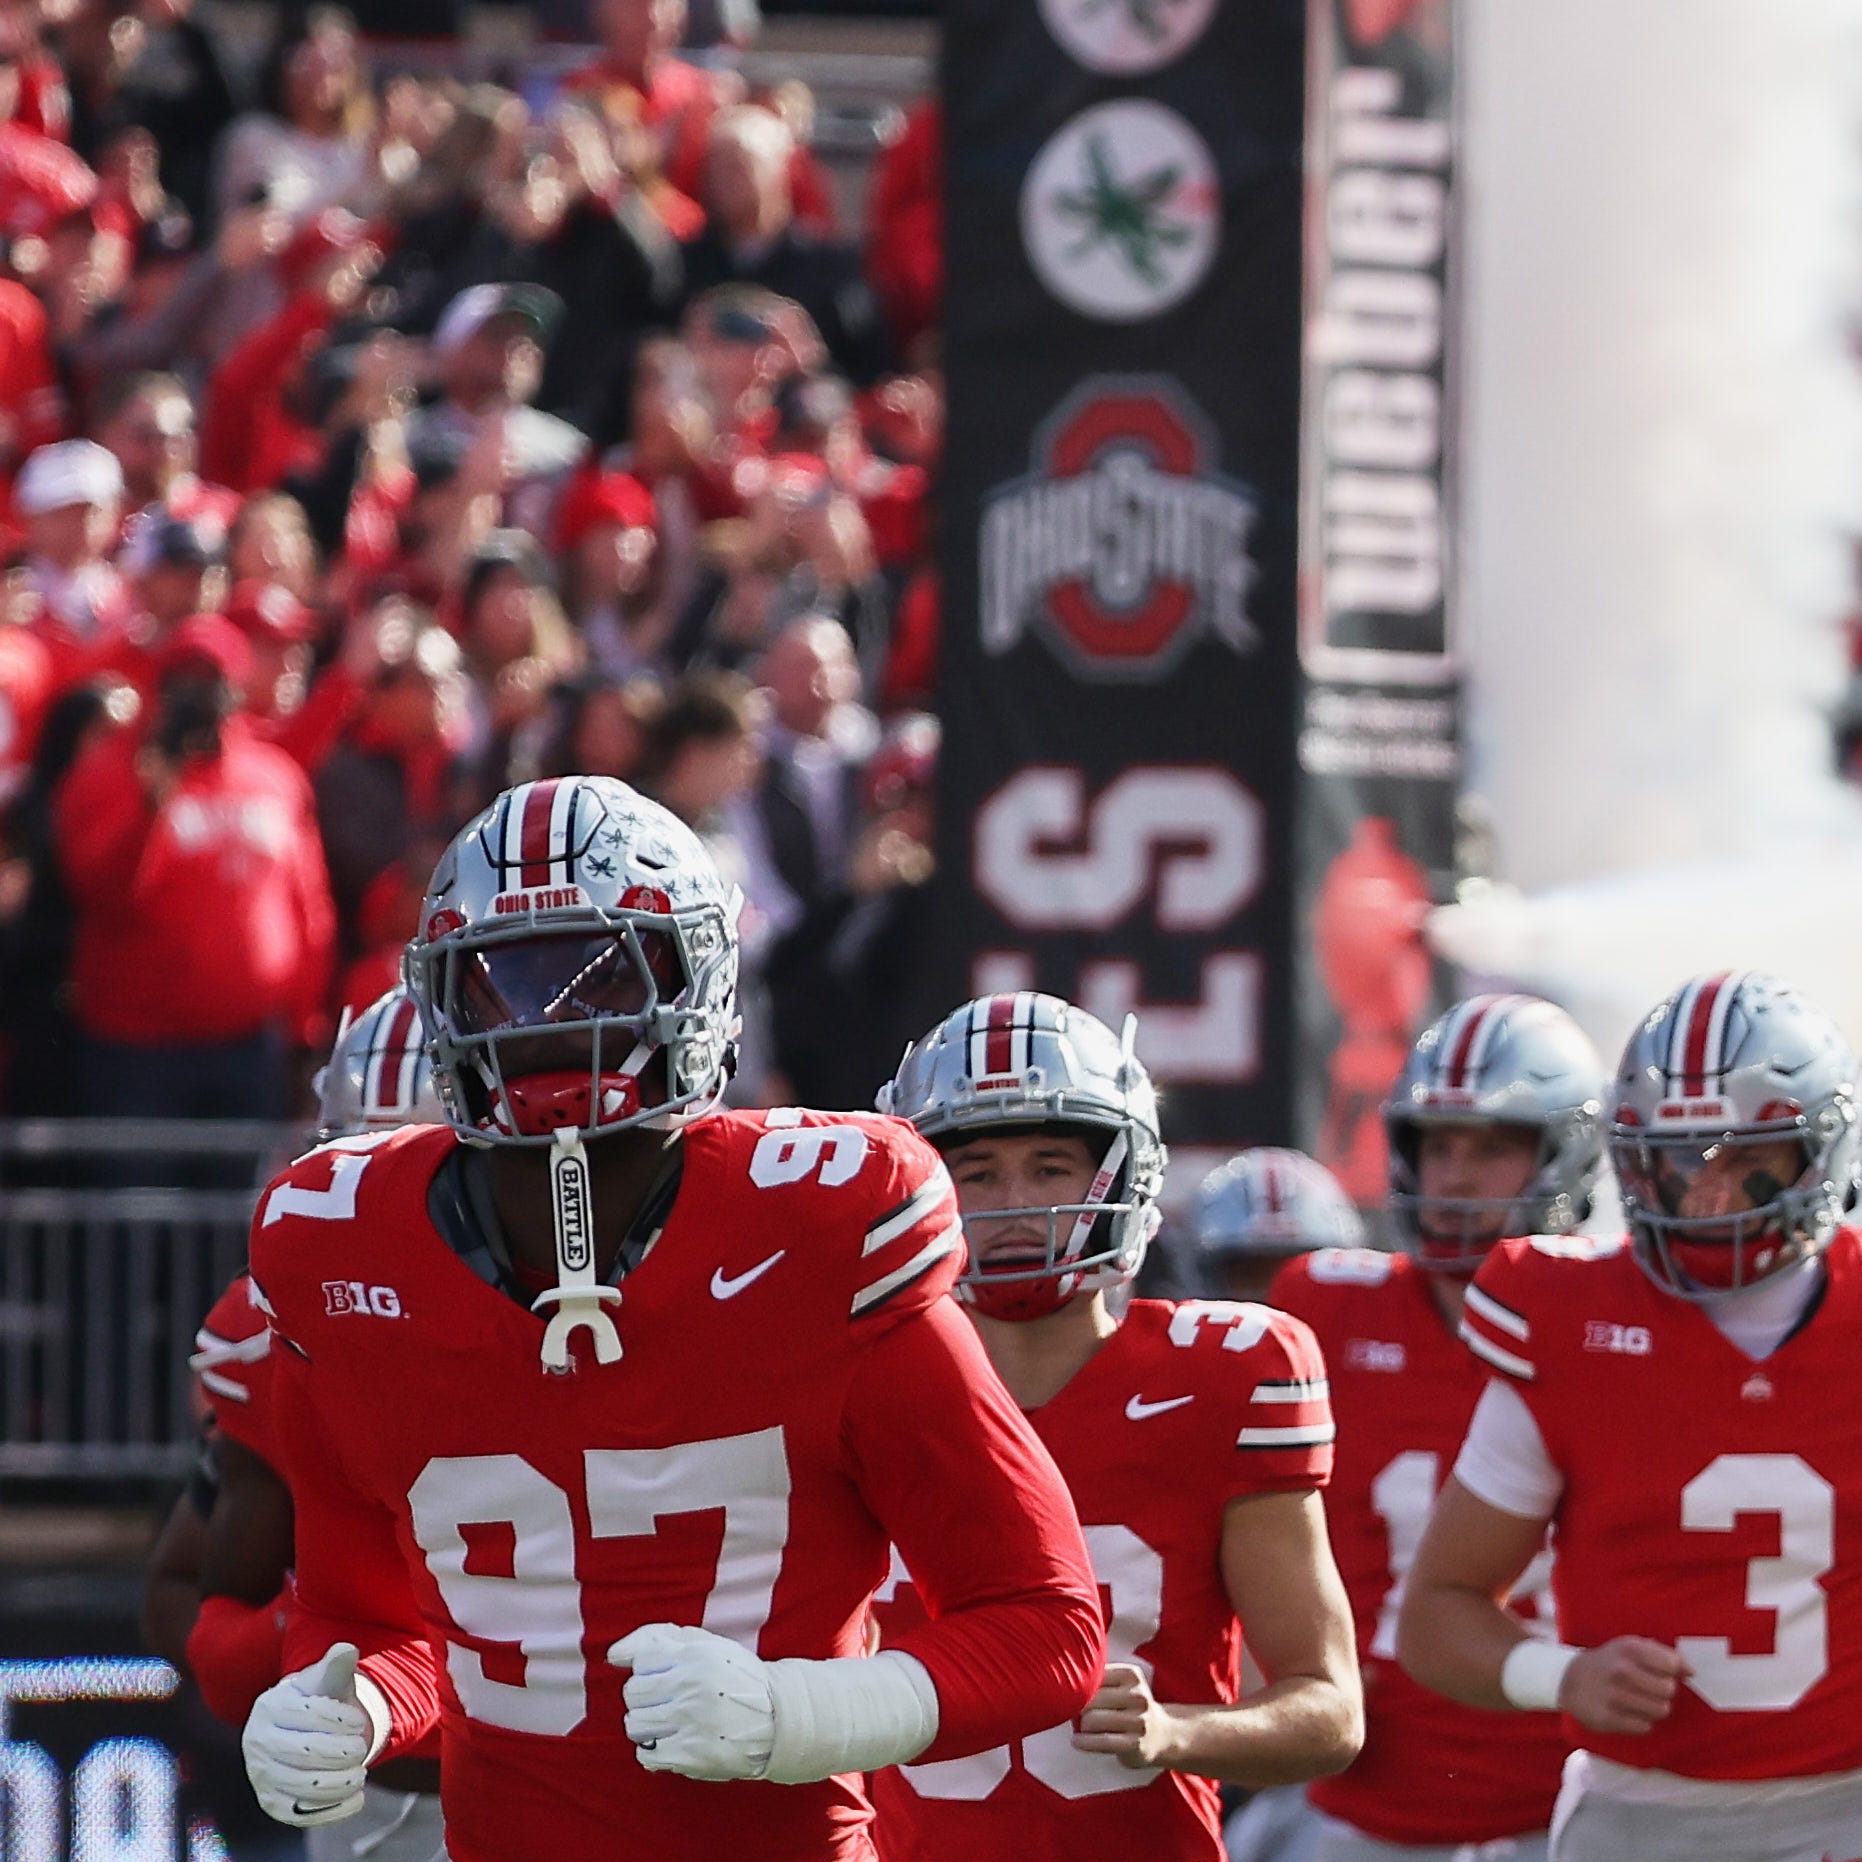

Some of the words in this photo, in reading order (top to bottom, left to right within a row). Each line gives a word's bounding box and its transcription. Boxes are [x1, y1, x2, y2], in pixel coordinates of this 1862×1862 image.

[1312, 66, 1450, 614] weber
[495, 893, 530, 914] OHIO
[535, 887, 580, 909] STATE
[562, 1167, 585, 1260] BATTLE
[407, 1425, 793, 1738] 97
[1675, 1452, 1836, 1713] 3
